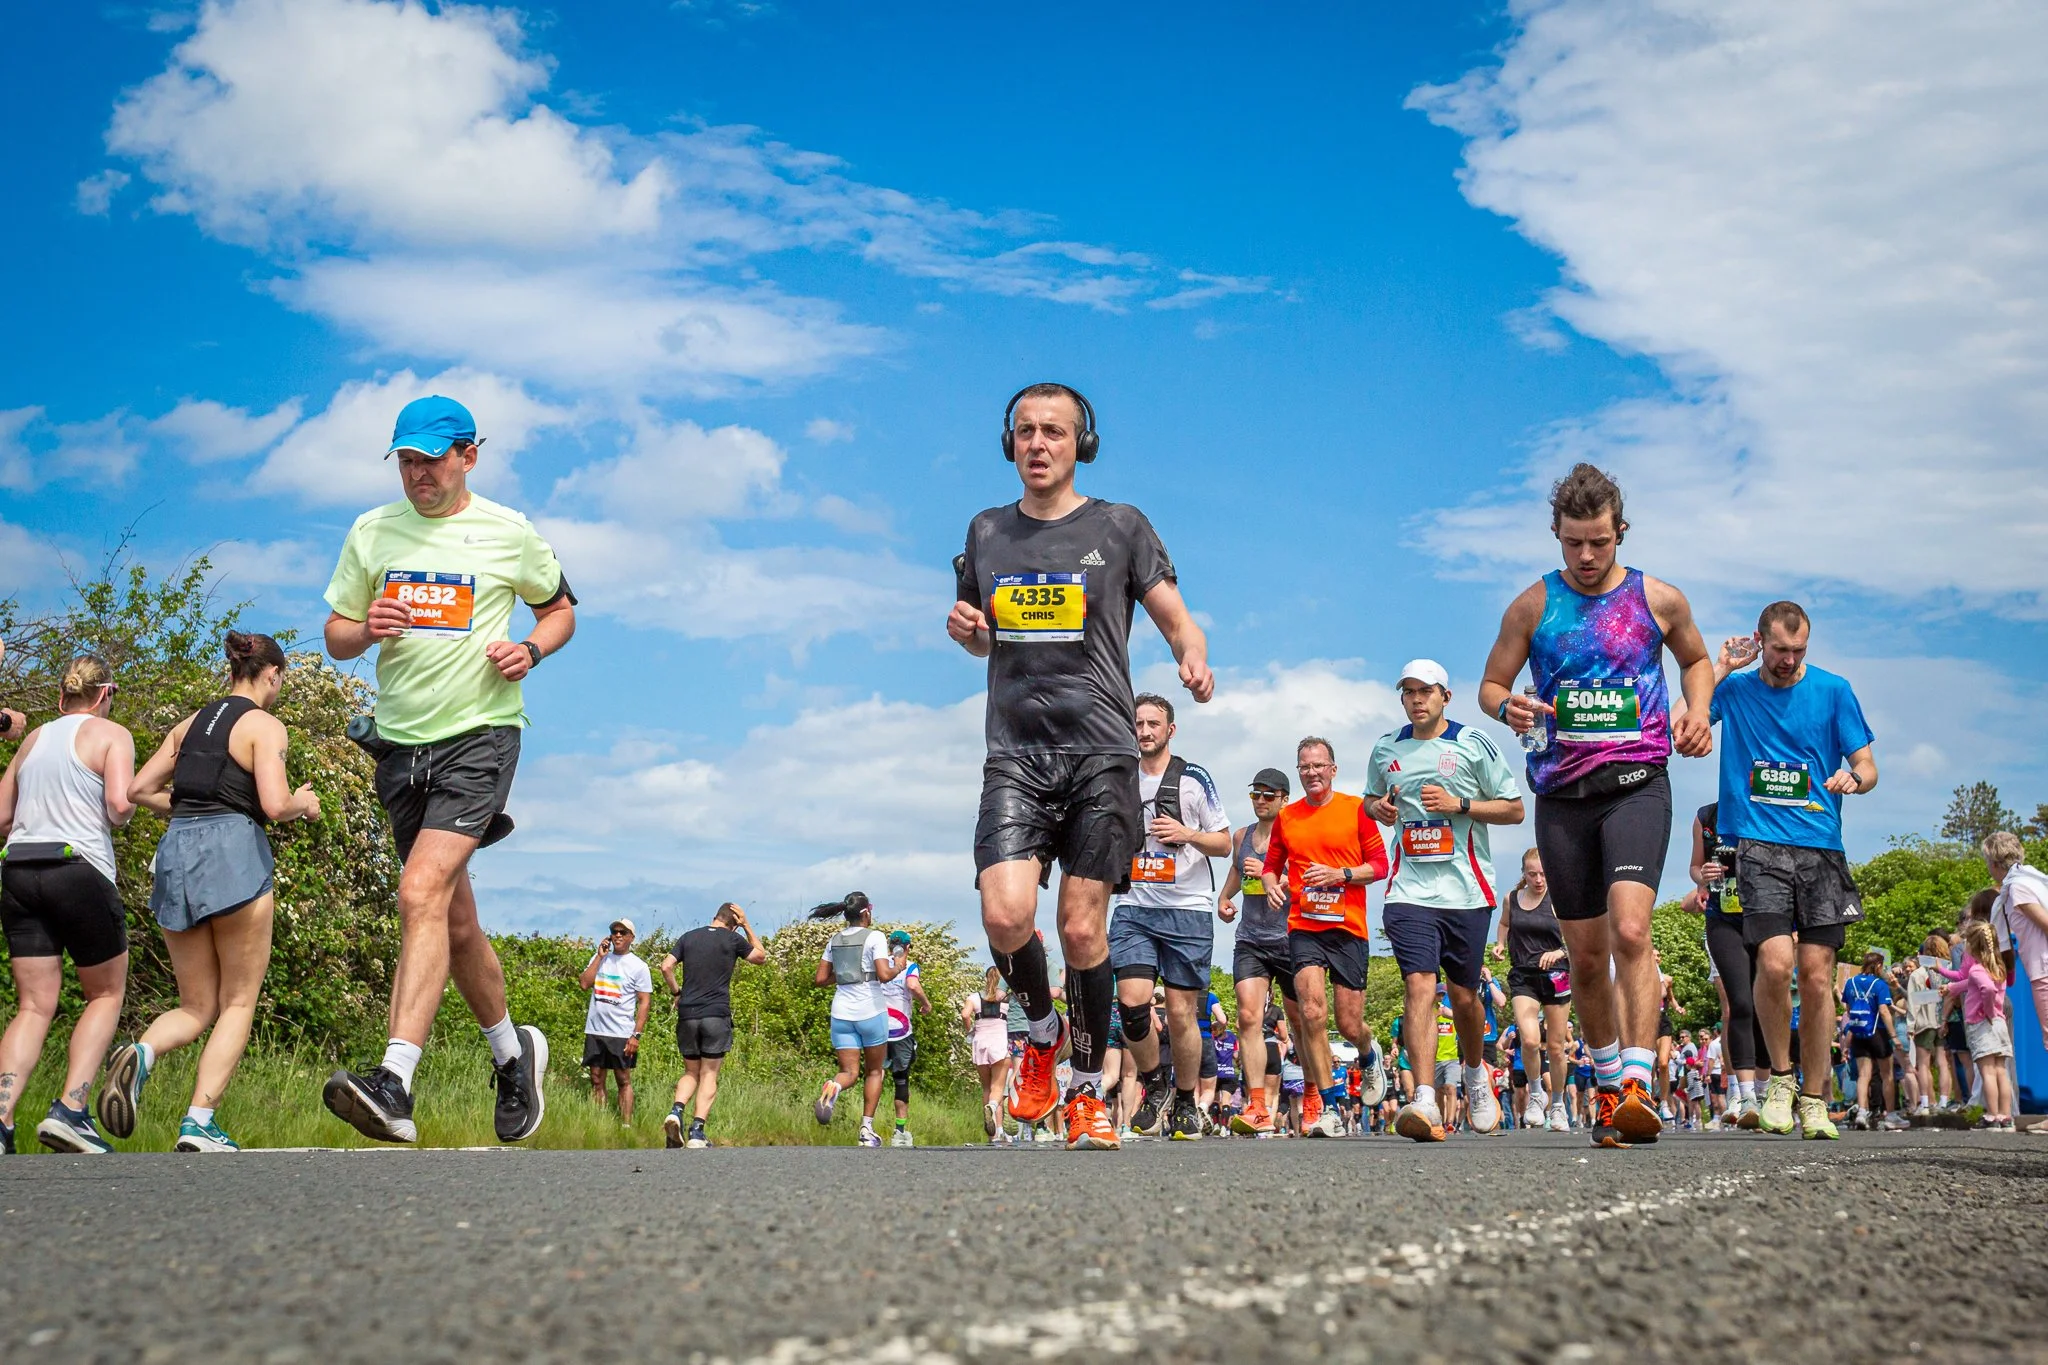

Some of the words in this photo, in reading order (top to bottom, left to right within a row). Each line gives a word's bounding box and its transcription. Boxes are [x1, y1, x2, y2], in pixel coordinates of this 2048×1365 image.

[398, 585, 456, 606] 8632
[1010, 588, 1066, 606] 4335
[410, 608, 442, 618] ADAM
[1021, 611, 1055, 620] CHRIS
[1566, 691, 1624, 709] 5044
[1574, 713, 1617, 722] SEAMUS
[1618, 769, 1647, 784] EXEO
[1761, 769, 1801, 784] 6380
[1766, 784, 1793, 792] JOSEPH
[1410, 829, 1442, 841] 9160
[1307, 892, 1340, 903] 10257
